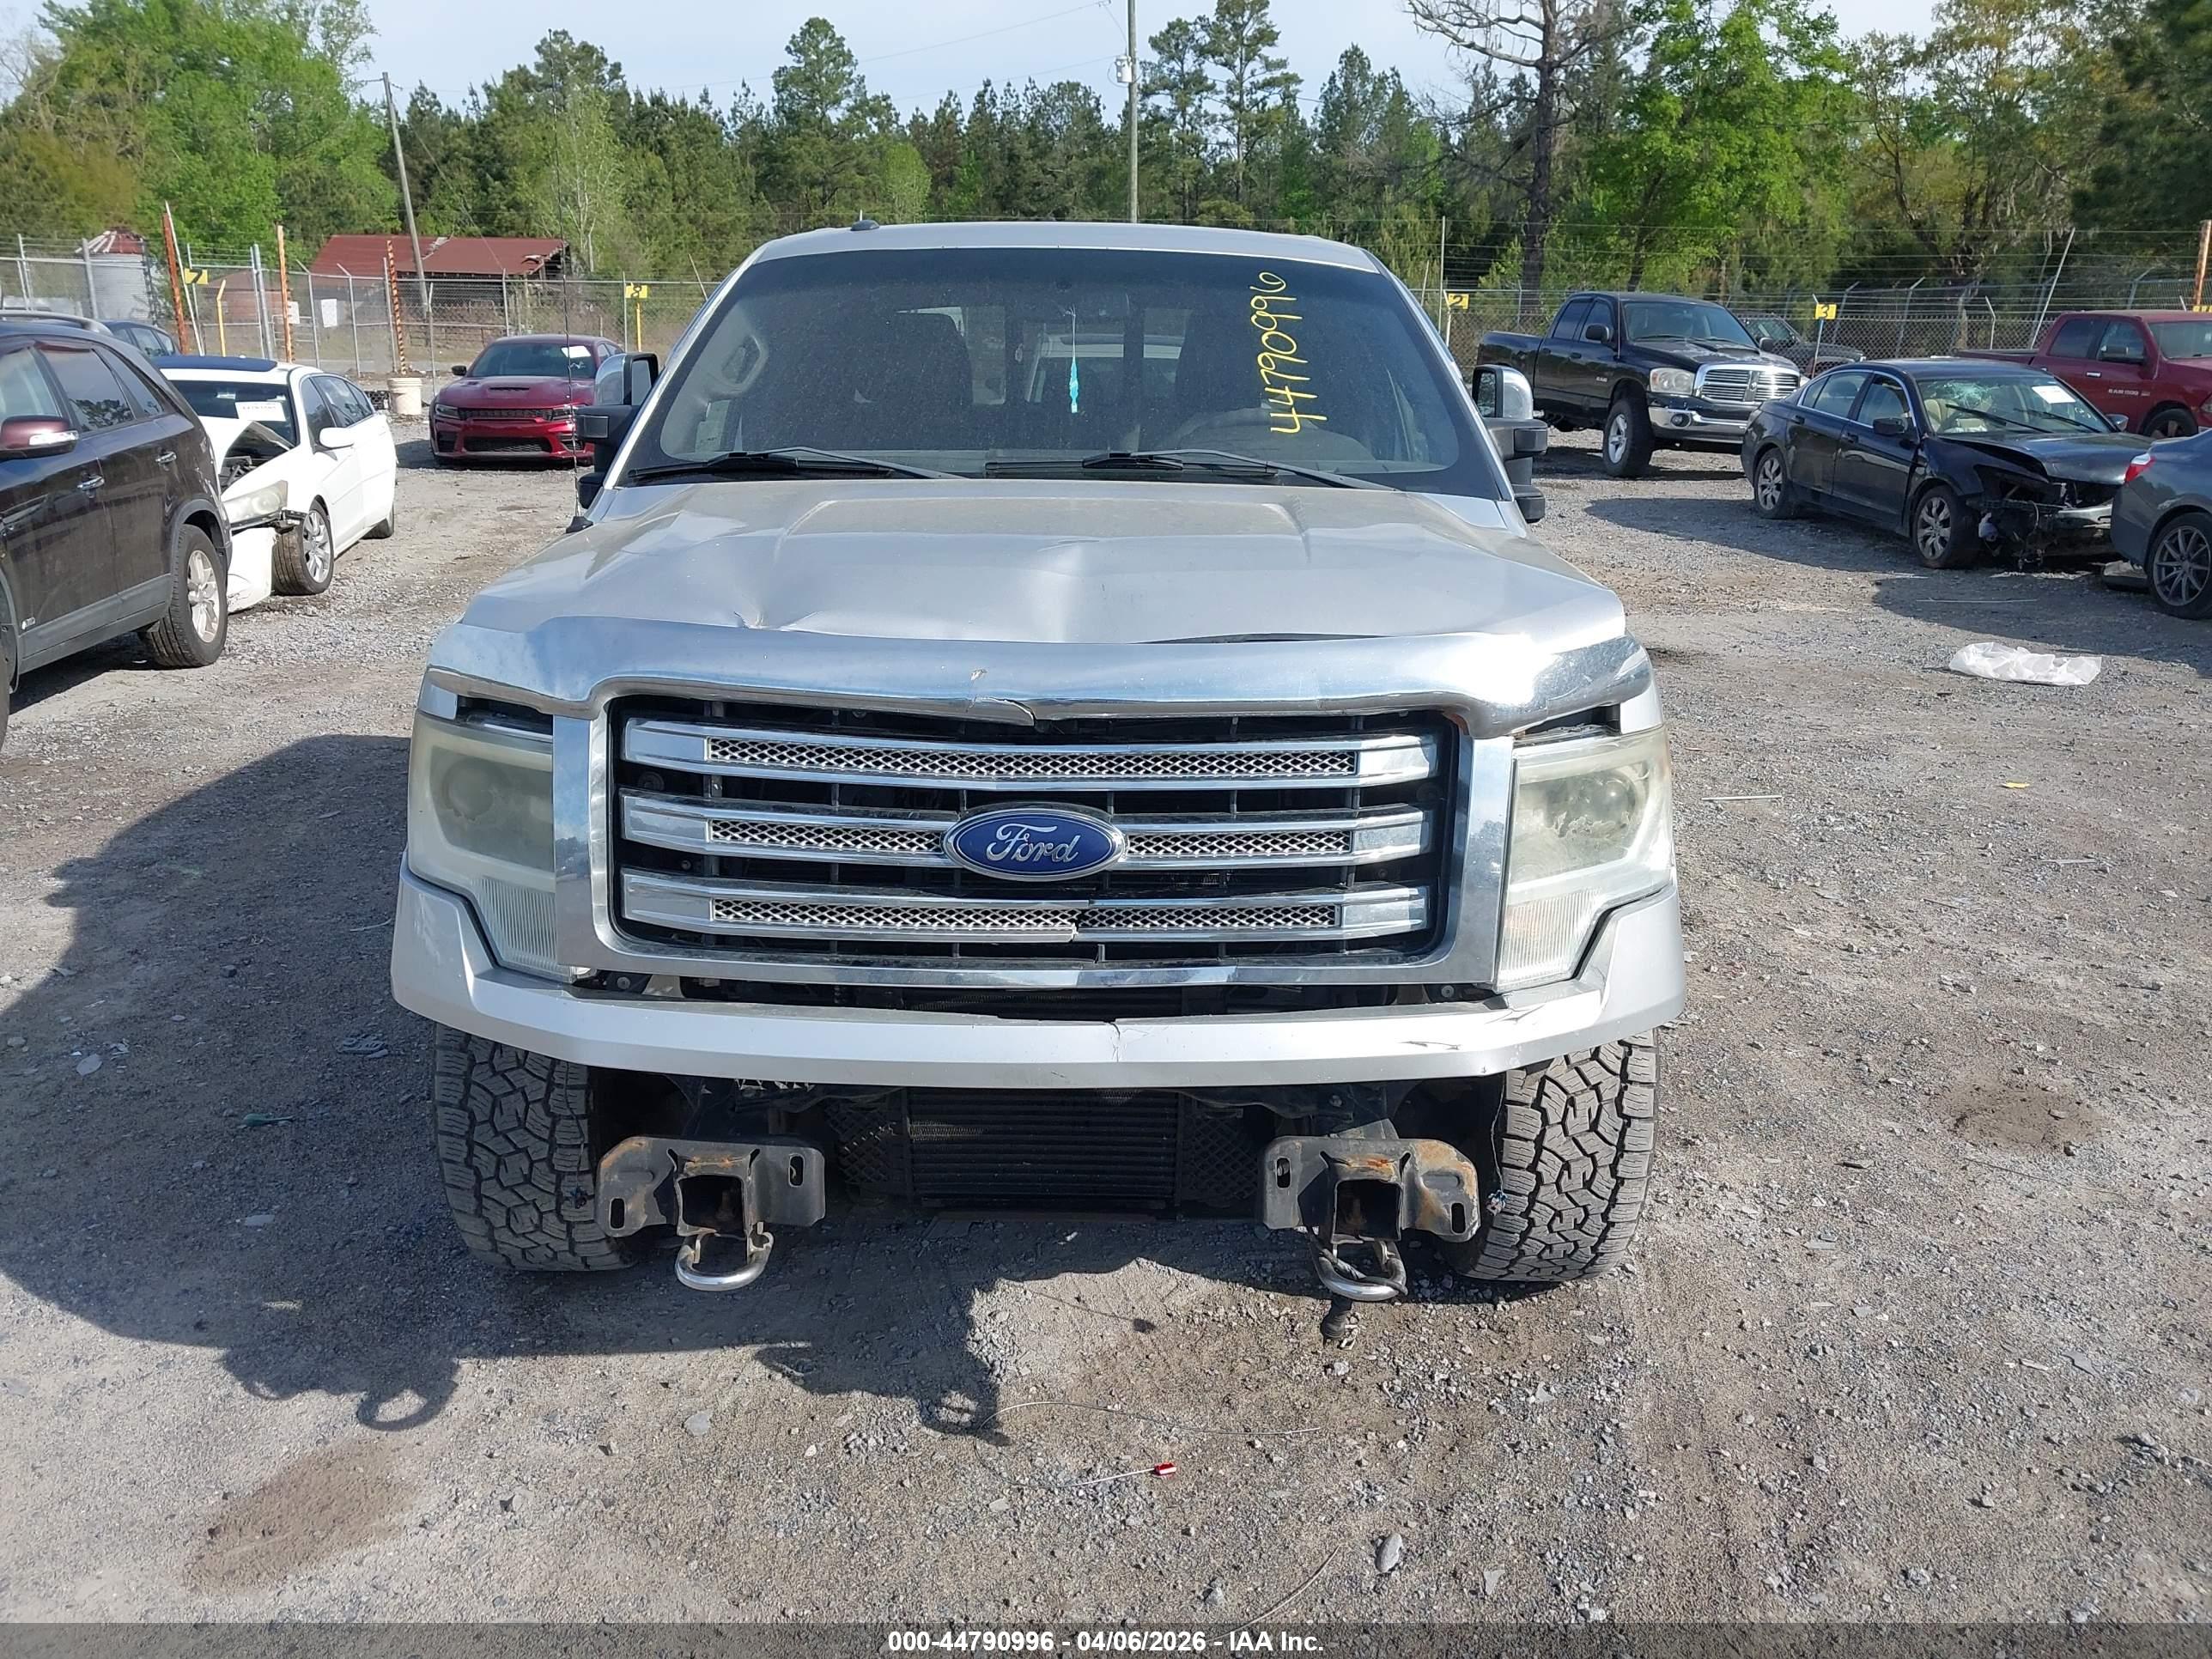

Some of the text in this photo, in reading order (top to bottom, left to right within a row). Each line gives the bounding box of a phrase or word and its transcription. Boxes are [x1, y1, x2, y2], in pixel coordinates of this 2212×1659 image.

[188, 267, 203, 284] 7
[630, 284, 642, 300] 8
[1449, 295, 1463, 308] 2
[1820, 304, 1830, 318] 3
[1249, 271, 1328, 434] 44790996
[987, 823, 1083, 863] Ford
